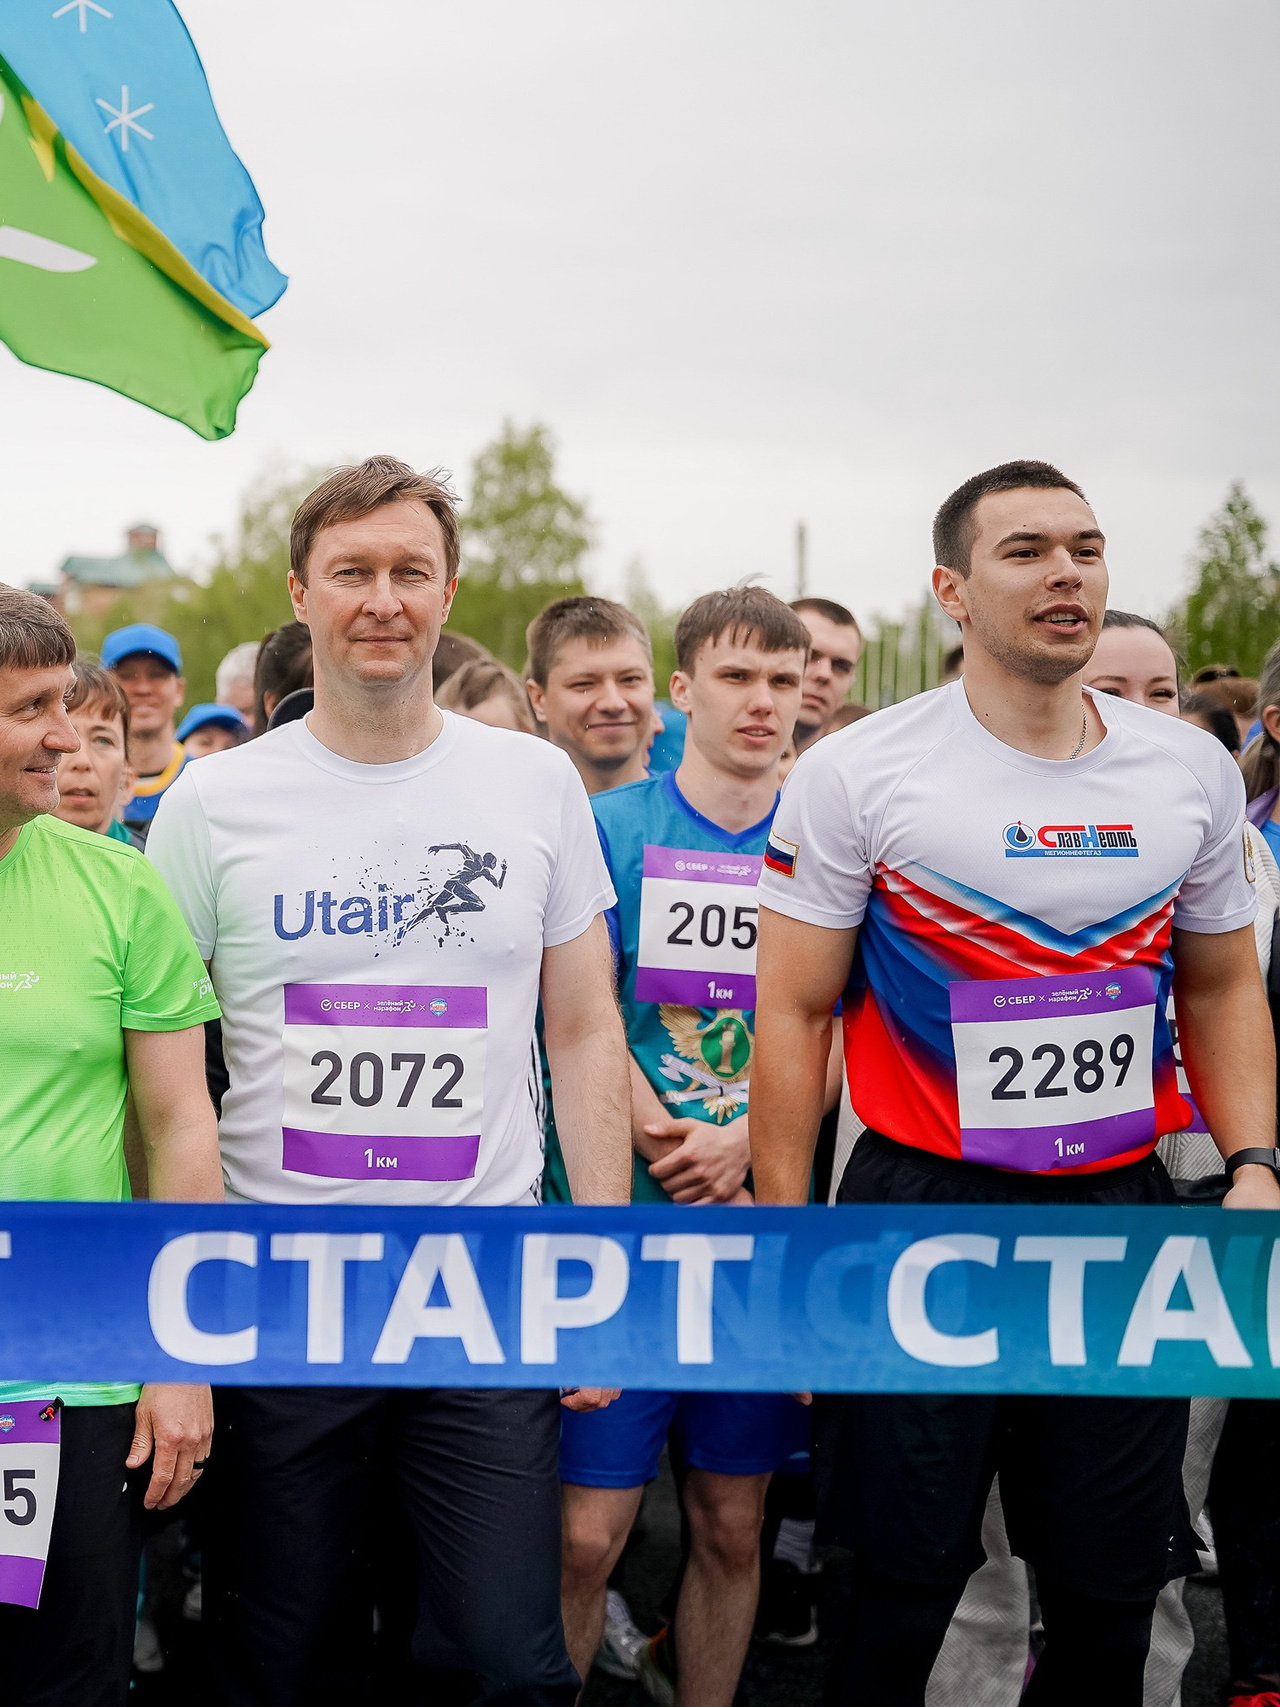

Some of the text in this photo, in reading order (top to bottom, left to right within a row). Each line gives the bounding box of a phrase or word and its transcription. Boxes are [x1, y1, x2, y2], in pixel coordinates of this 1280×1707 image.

[274, 884, 415, 941] Utair
[667, 901, 759, 950] 205
[333, 1001, 361, 1010] СБЕР
[1008, 995, 1036, 1005] СБЕР
[310, 1050, 465, 1108] 2072
[988, 1033, 1135, 1100] 2289
[147, 1230, 755, 1366] СТАРТ
[886, 1233, 1280, 1368] СТА
